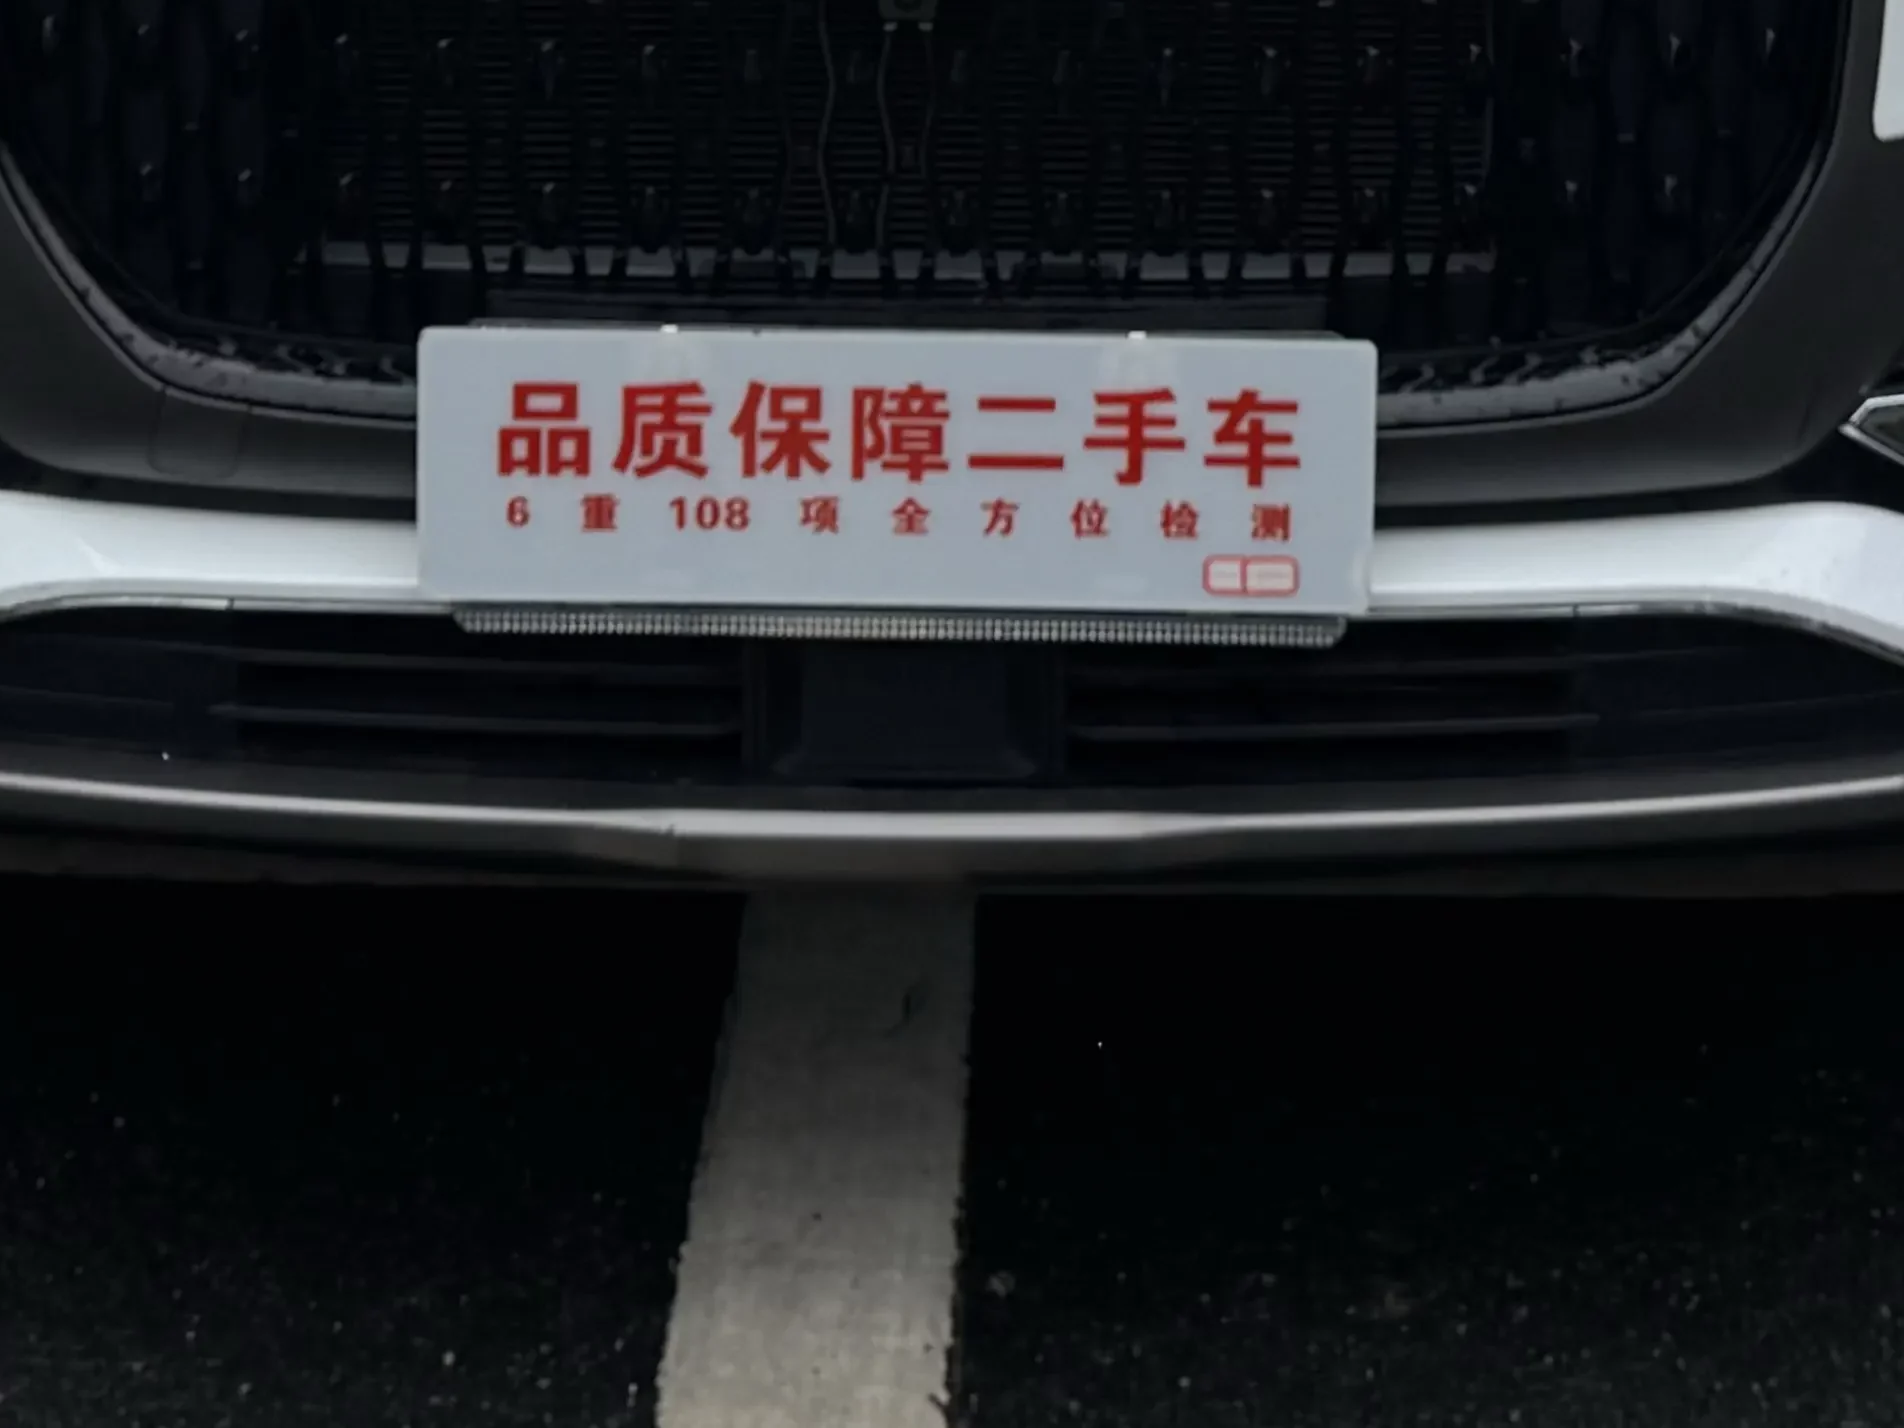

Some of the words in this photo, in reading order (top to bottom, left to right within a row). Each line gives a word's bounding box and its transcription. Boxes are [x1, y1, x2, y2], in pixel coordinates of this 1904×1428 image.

[496, 379, 1302, 489] 品质保障二手车
